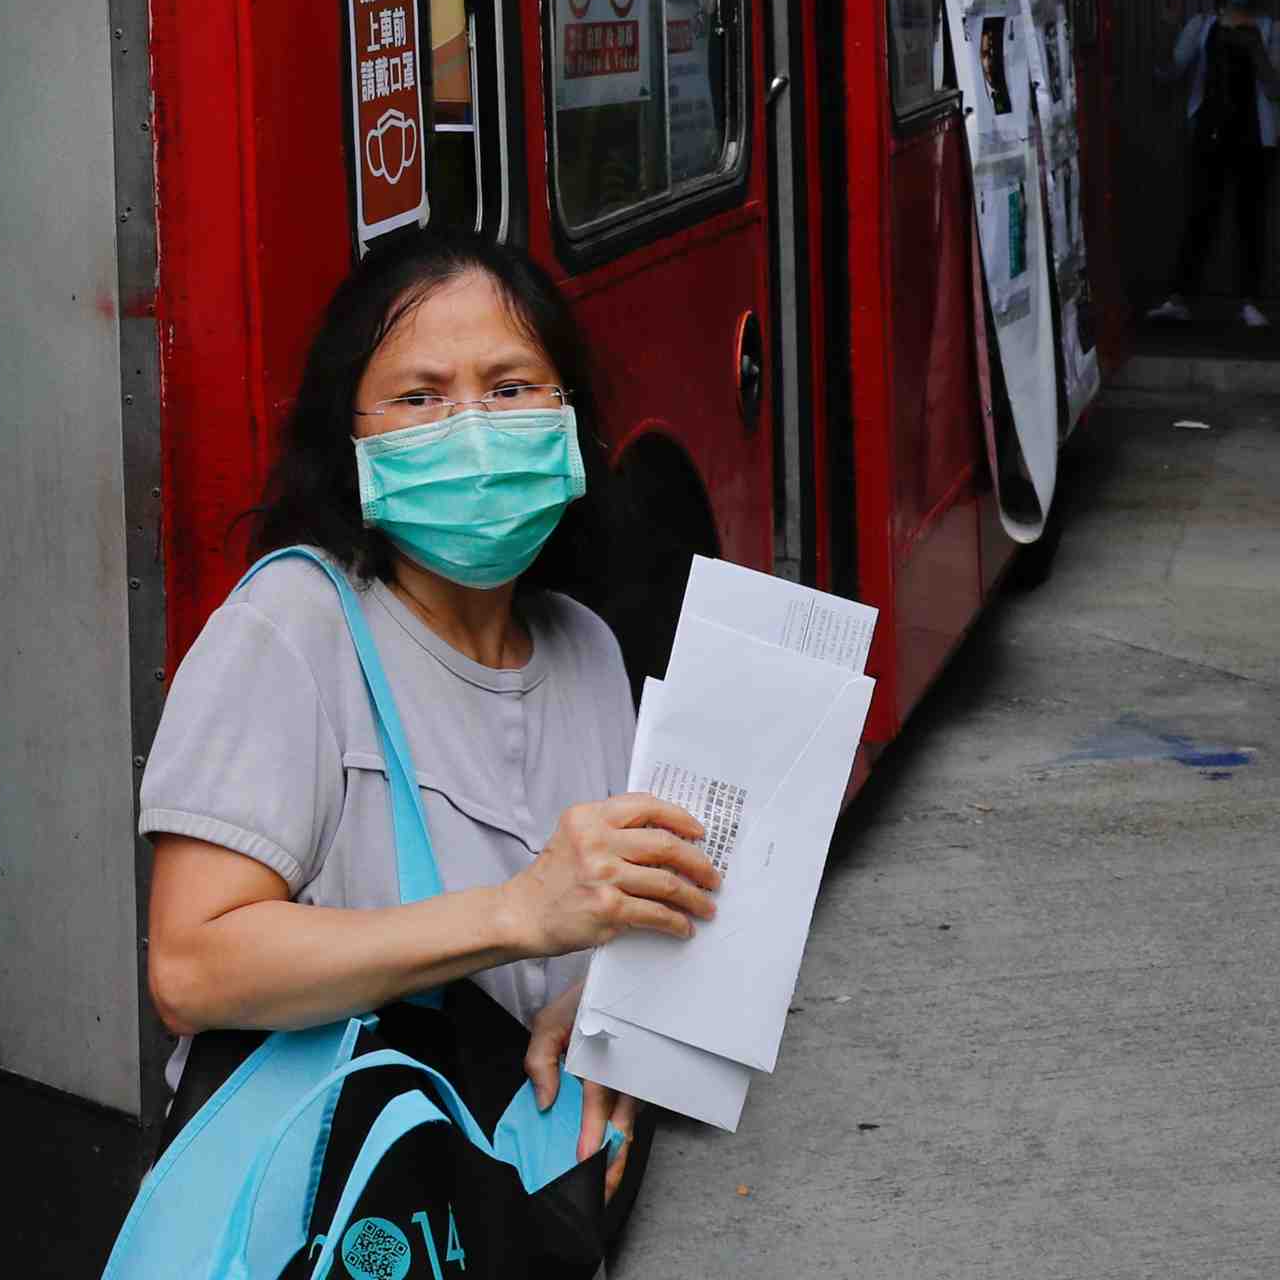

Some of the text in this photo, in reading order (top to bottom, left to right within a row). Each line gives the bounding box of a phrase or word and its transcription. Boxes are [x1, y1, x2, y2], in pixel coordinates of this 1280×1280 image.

[366, 5, 408, 53] 上車前
[360, 50, 416, 103] 請戴口罩
